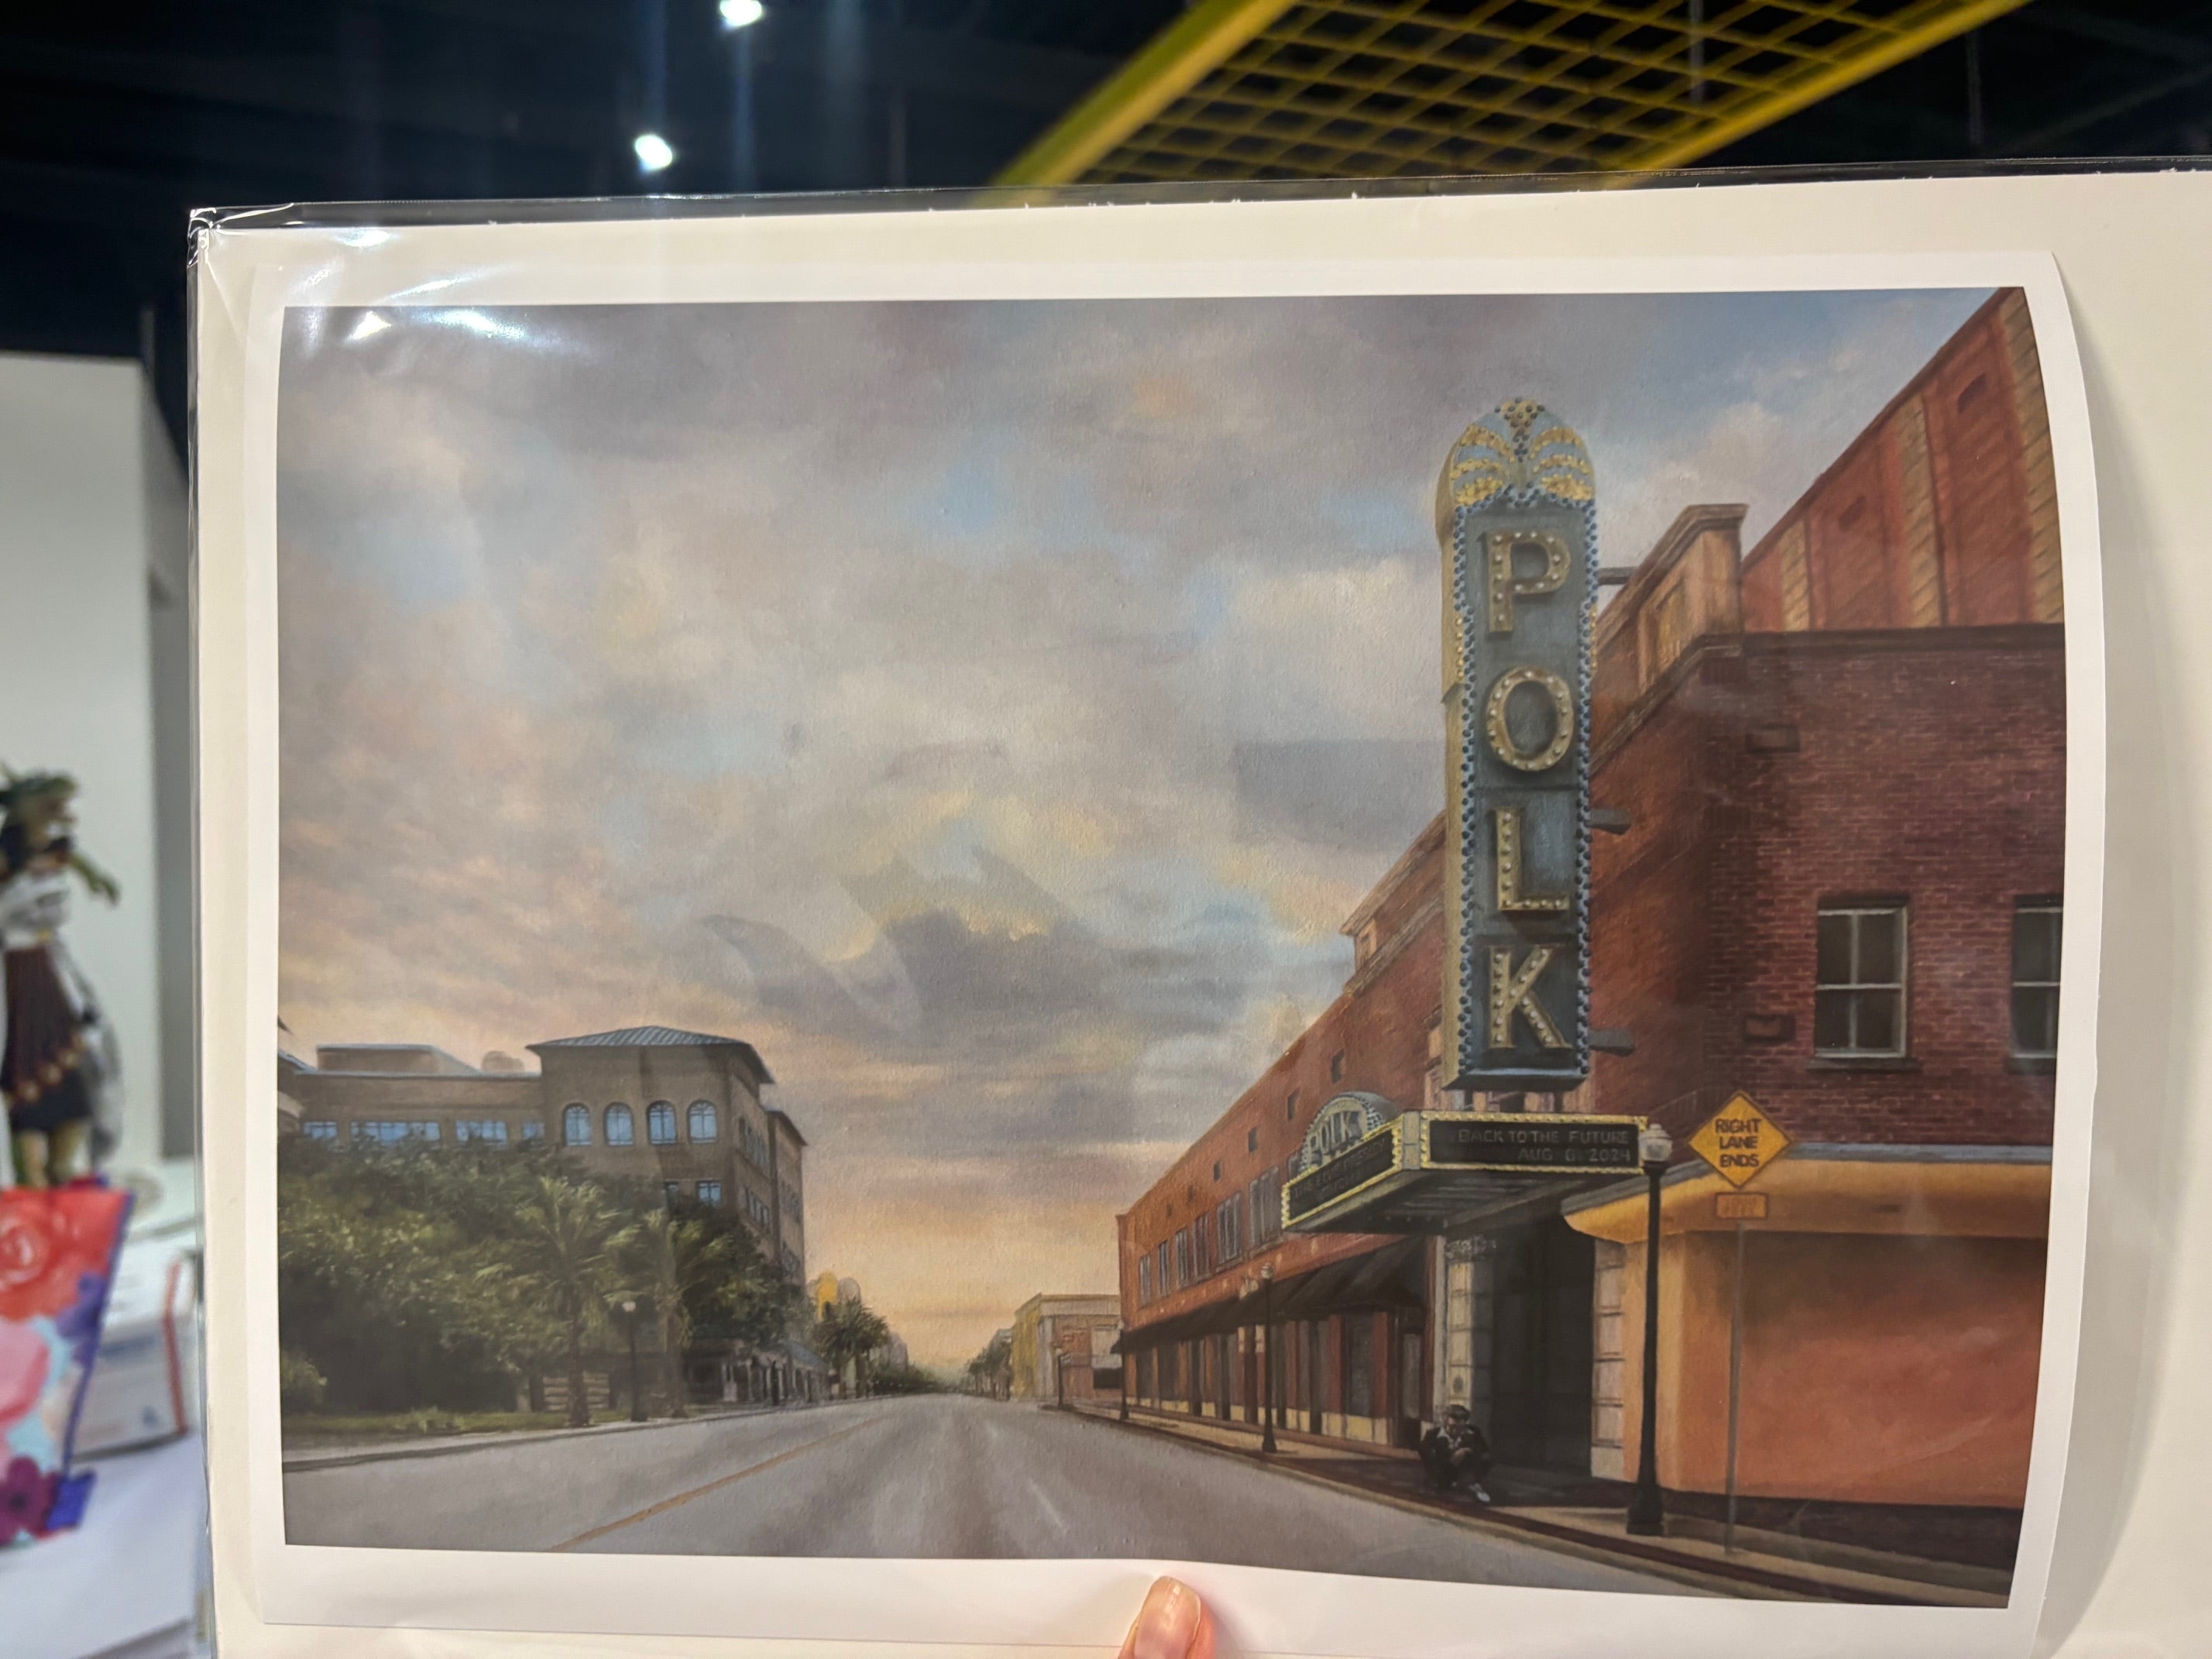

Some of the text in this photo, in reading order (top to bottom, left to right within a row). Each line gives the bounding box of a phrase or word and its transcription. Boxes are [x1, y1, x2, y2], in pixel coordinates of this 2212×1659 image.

[1484, 529, 1575, 1049] POLK
[1716, 1118, 1761, 1133] RIGHT
[1307, 1111, 1352, 1163] POLK
[1458, 1129, 1629, 1145] BACK TO THE FUTURE
[1719, 1136, 1757, 1149] LANE
[1518, 1147, 1554, 1161] AUG
[1589, 1148, 1631, 1162] 2024
[1720, 1154, 1760, 1167] ENDS
